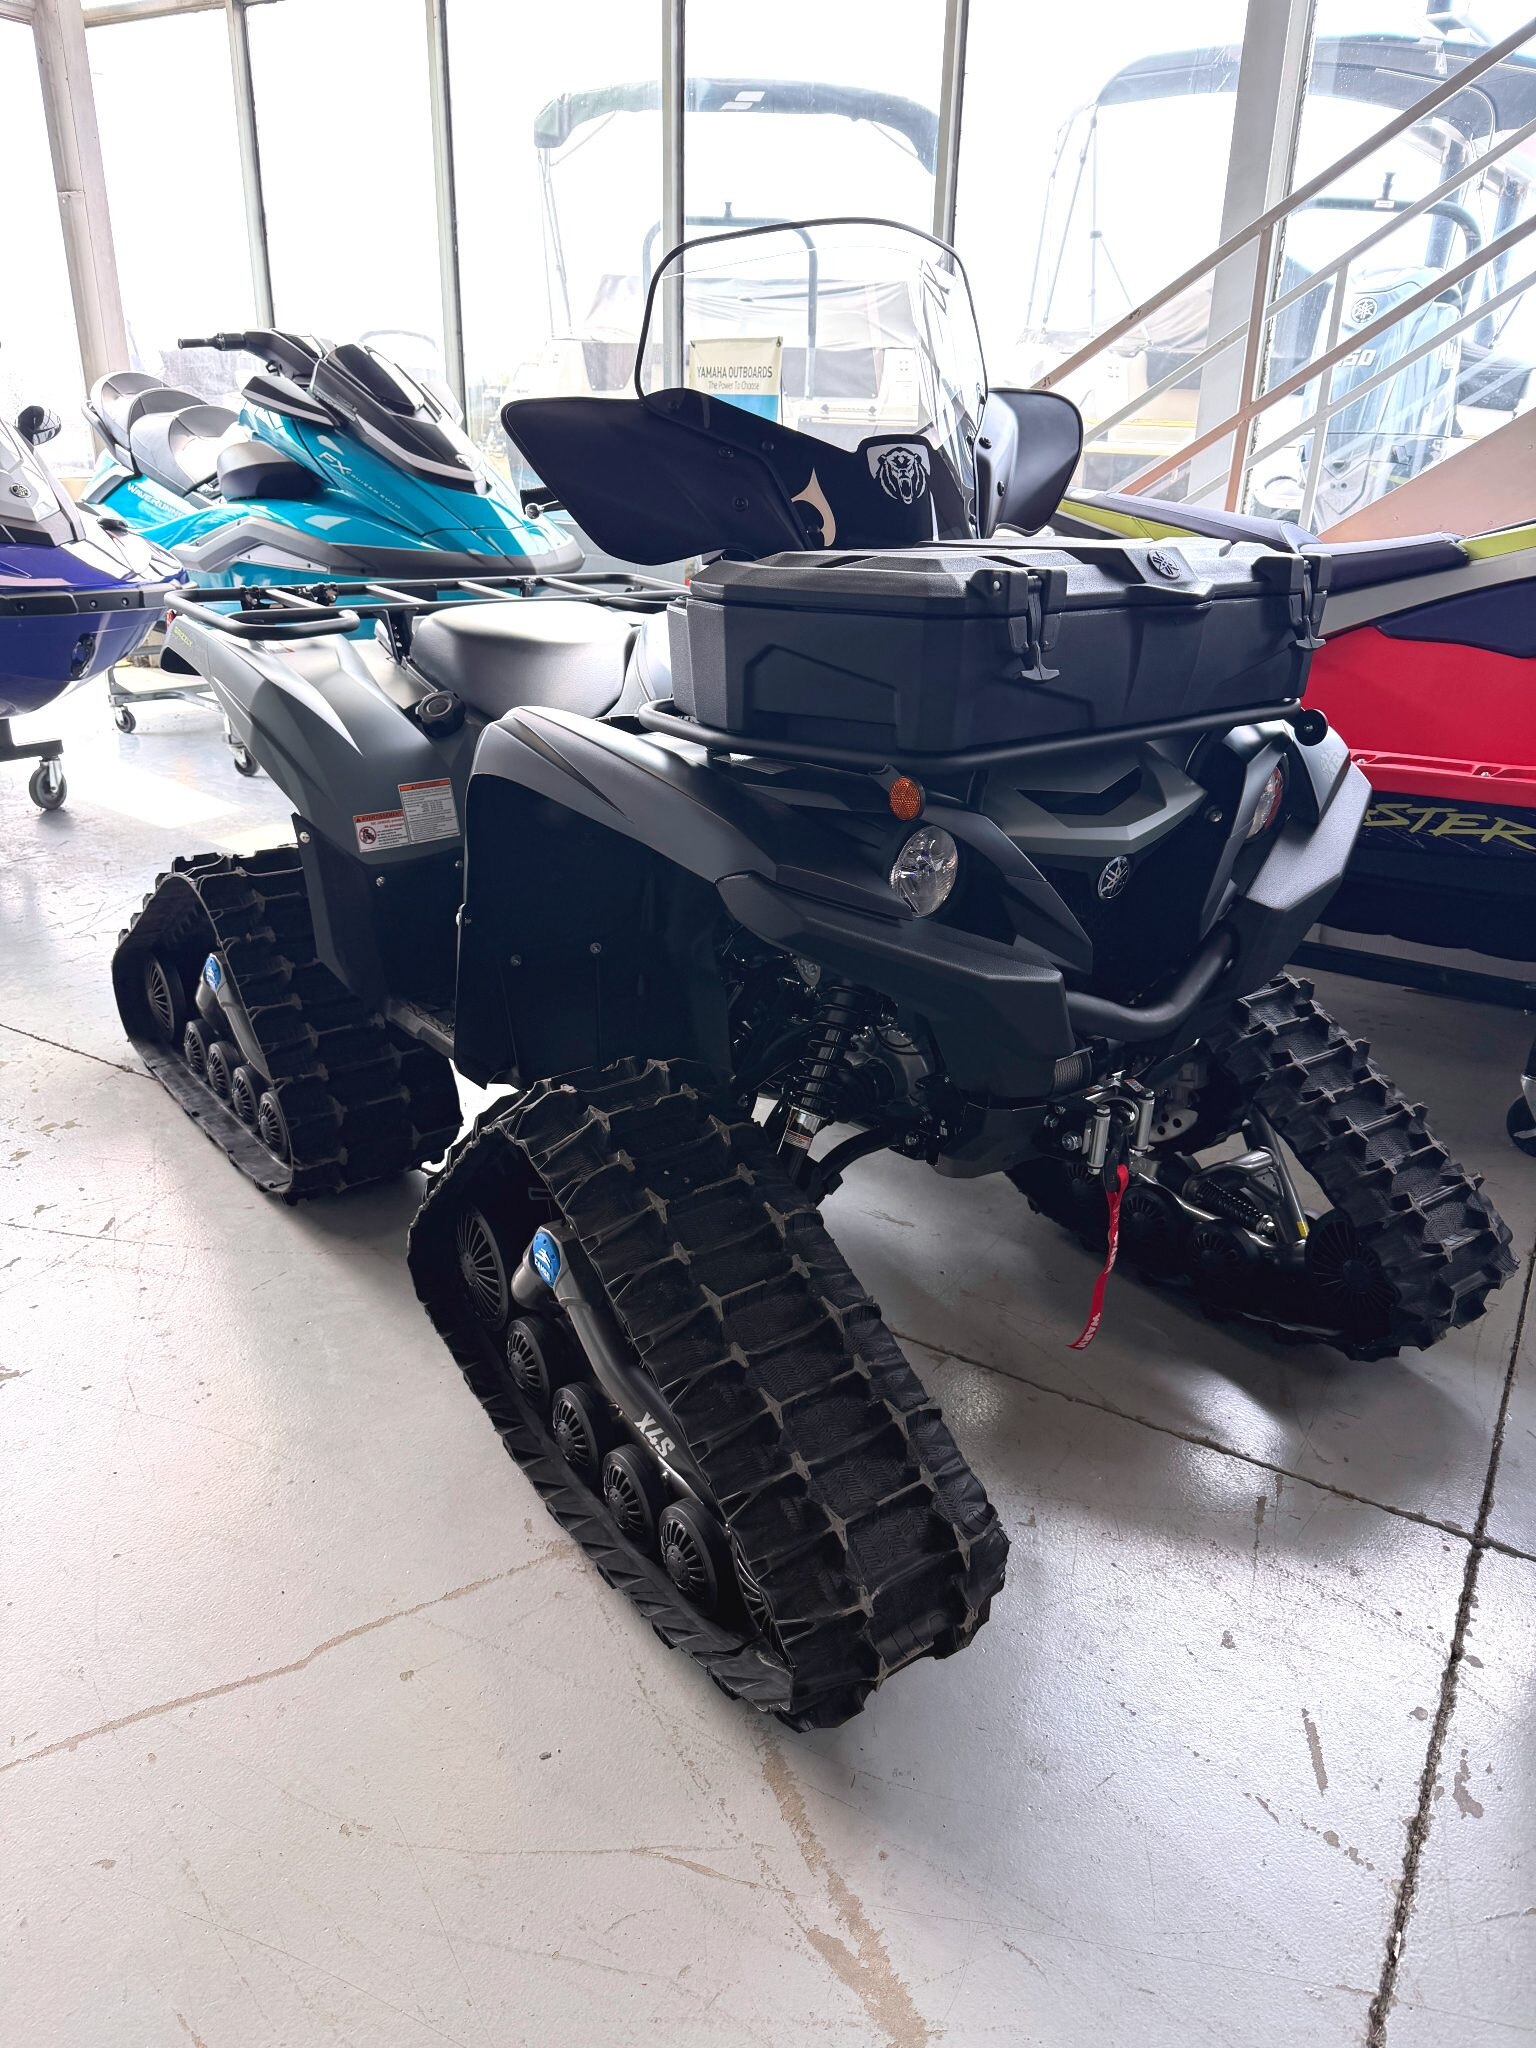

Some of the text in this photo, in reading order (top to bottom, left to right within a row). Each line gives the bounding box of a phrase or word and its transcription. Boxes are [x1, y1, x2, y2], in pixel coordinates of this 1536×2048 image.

[697, 365, 773, 379] YAMAHA OUTBOARDS
[708, 380, 718, 390] The
[718, 380, 733, 390] Power
[741, 380, 760, 390] Choose
[319, 451, 353, 475] FX
[1363, 803, 1536, 850] STER
[634, 1411, 676, 1458] X4S
